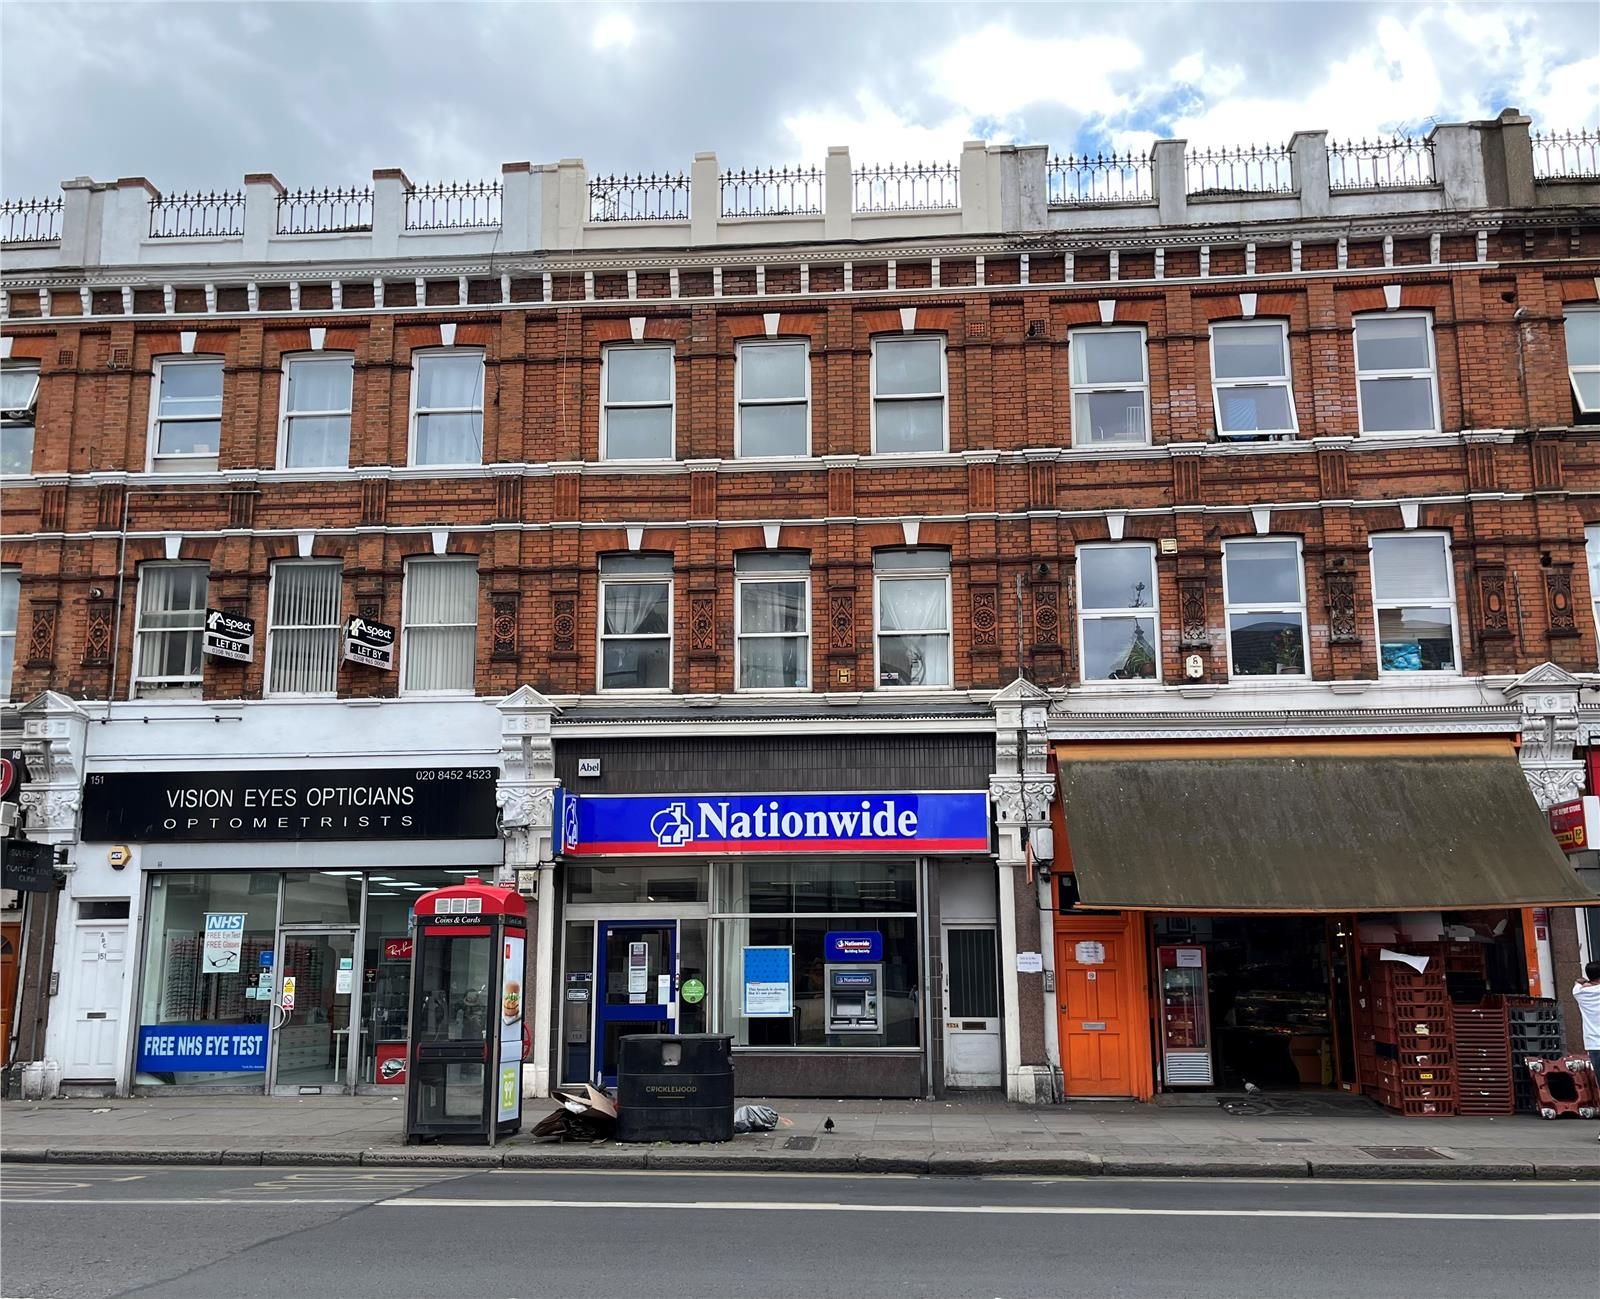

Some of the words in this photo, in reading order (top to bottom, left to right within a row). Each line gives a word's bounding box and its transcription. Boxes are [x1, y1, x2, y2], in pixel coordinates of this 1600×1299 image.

[213, 612, 251, 631] Aspect
[356, 618, 391, 639] Aspect
[216, 639, 230, 649] LET
[231, 642, 242, 651] BY
[357, 646, 371, 656] LET
[372, 650, 382, 659] BY
[580, 763, 599, 773] Abel
[90, 776, 104, 785] 151
[416, 771, 434, 781] 020
[437, 770, 463, 780] 8452
[465, 769, 492, 780] 4523
[166, 789, 234, 808] VISION
[244, 788, 297, 807] EYES
[306, 786, 414, 806] OPTICIANS
[163, 815, 413, 829] OPTOMETRISTS
[697, 800, 918, 838] Nationwide
[209, 916, 241, 929] NHS
[435, 916, 453, 924] Coins
[454, 916, 460, 924] &
[461, 916, 481, 924] Cards
[144, 1036, 175, 1056] FREE
[177, 1035, 203, 1056] NHS
[205, 1035, 229, 1055] EYE
[232, 1035, 263, 1055] TEST
